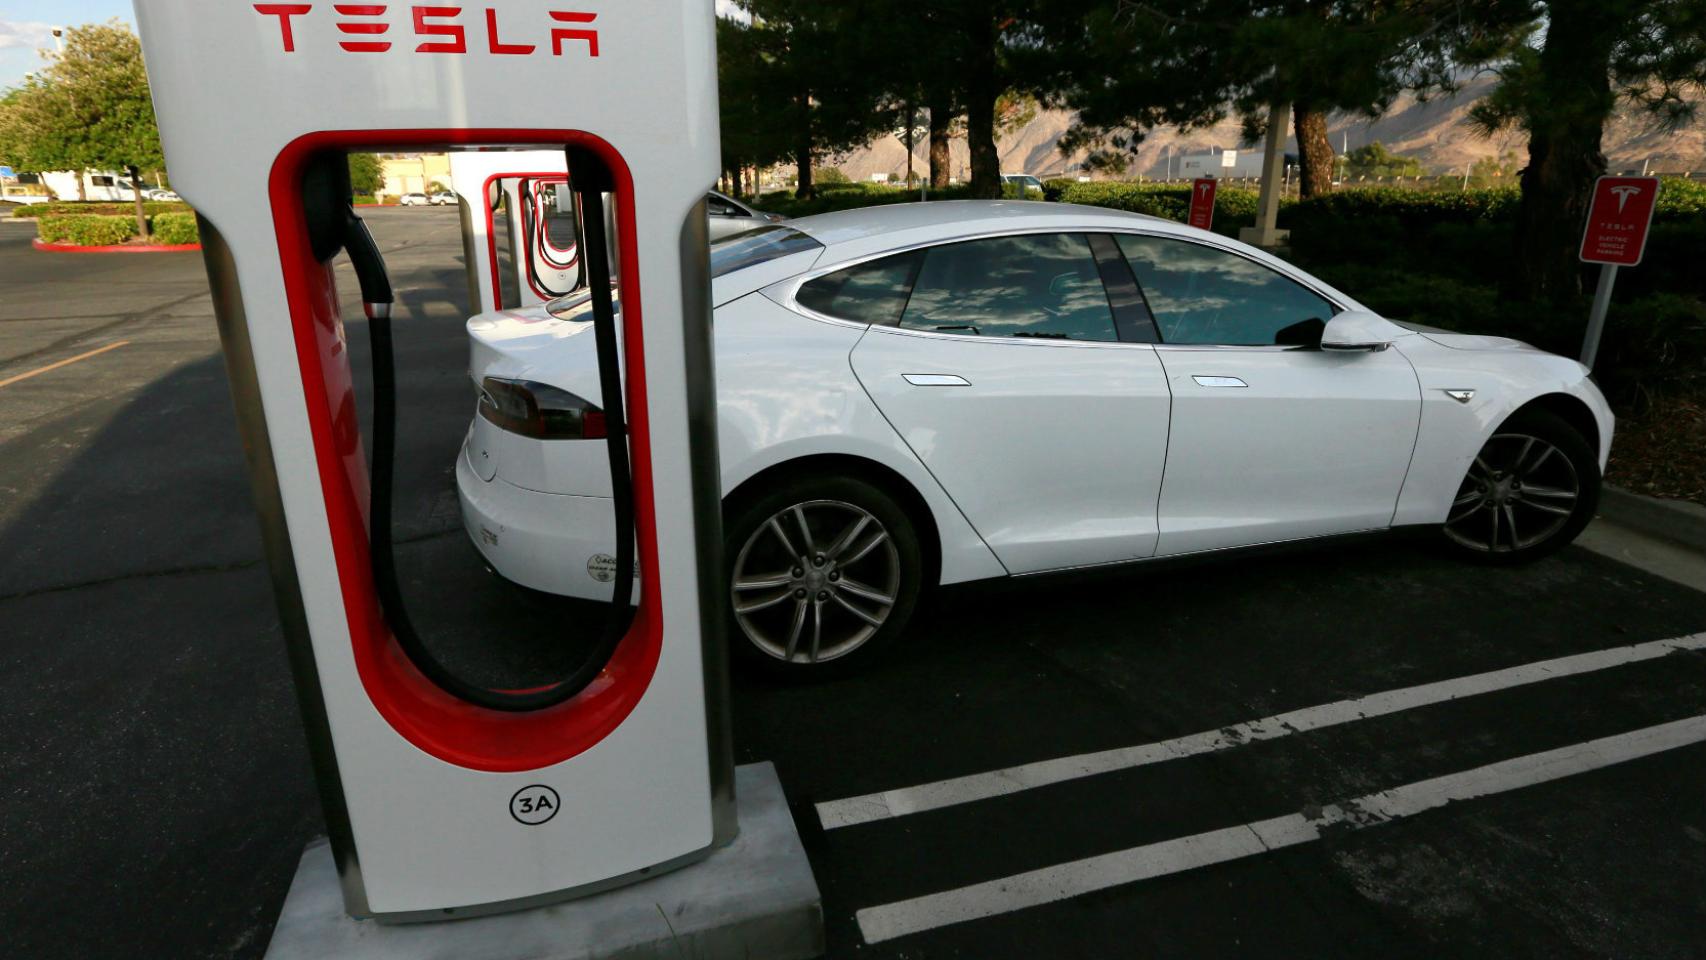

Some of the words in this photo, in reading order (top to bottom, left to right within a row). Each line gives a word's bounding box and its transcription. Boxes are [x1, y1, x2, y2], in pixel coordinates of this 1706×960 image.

[252, 4, 599, 57] TESLA
[1600, 223, 1635, 231] TESLA
[518, 795, 553, 813] 3A
